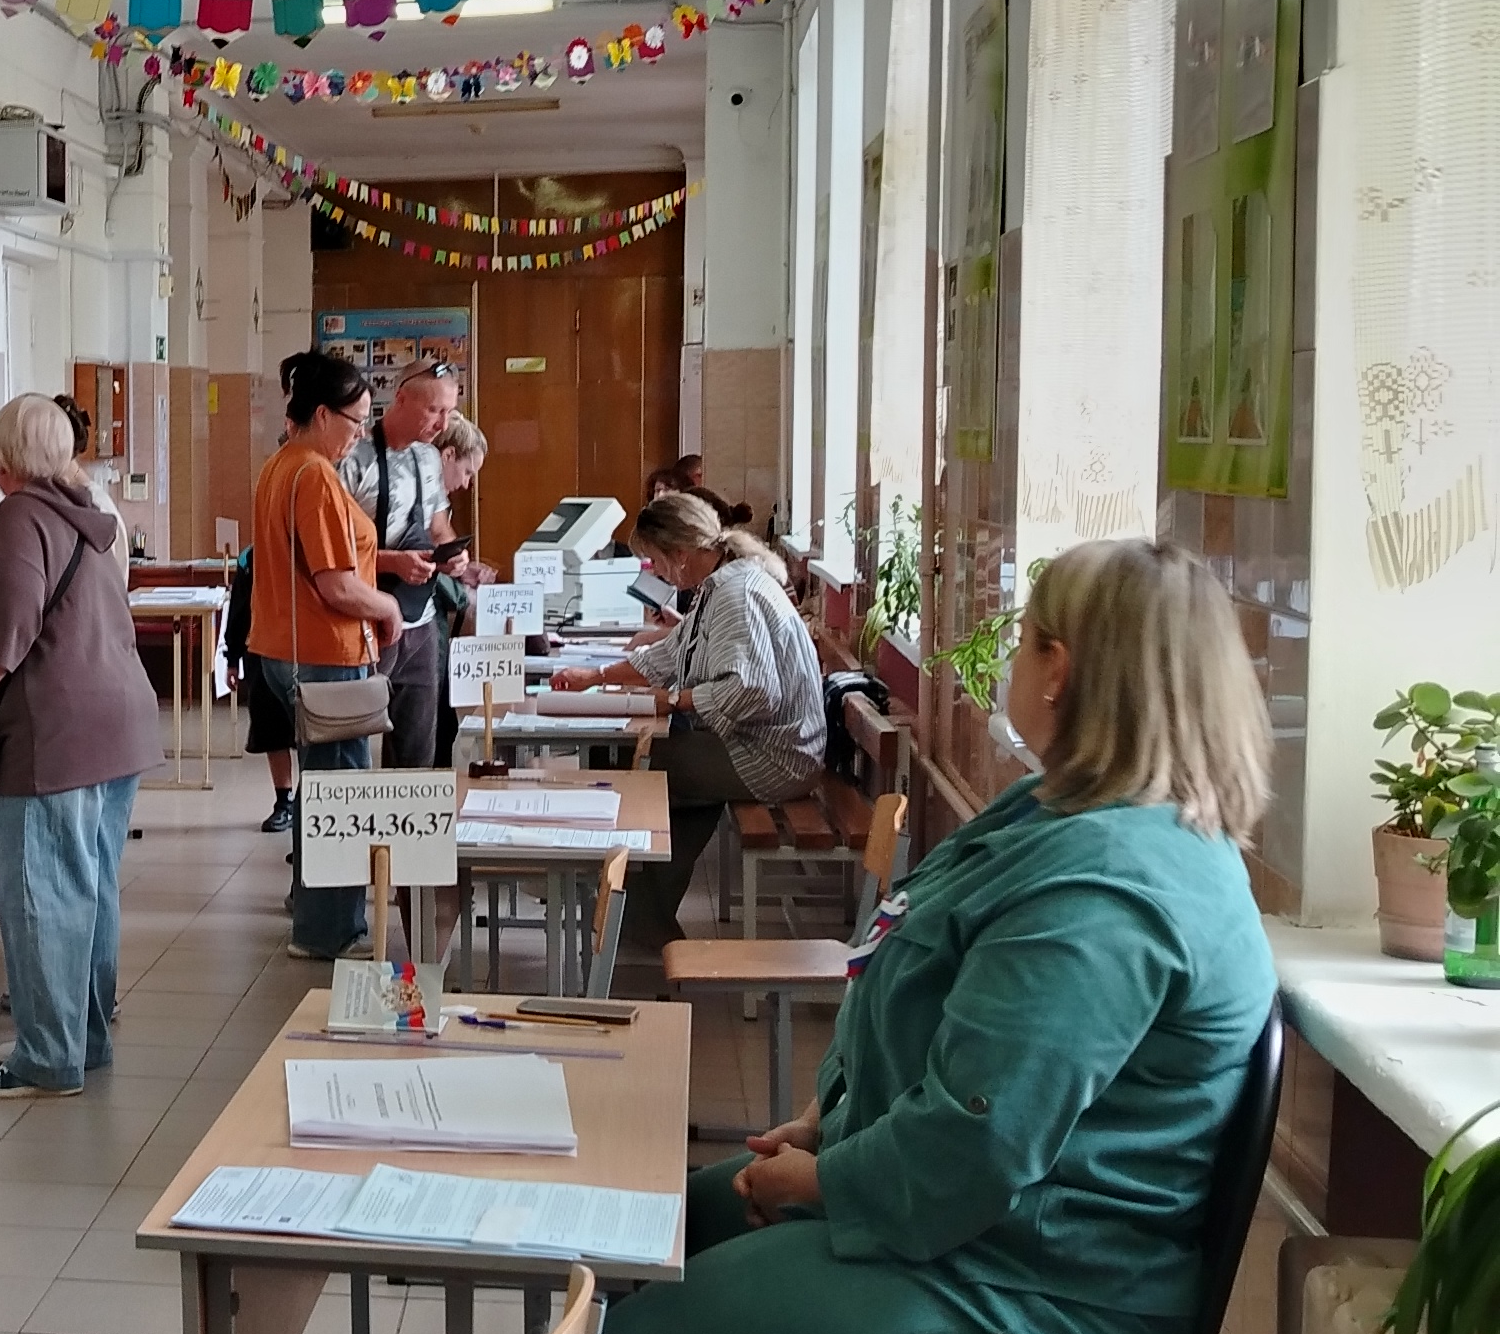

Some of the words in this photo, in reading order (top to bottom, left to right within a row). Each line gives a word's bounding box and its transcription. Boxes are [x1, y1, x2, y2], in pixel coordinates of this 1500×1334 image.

[488, 588, 534, 599] Дегтярева
[487, 602, 533, 616] 45,47,51
[453, 641, 523, 655] Дзержинского
[306, 781, 454, 804] Дзержинского
[306, 812, 454, 843] 32,34,36,37
